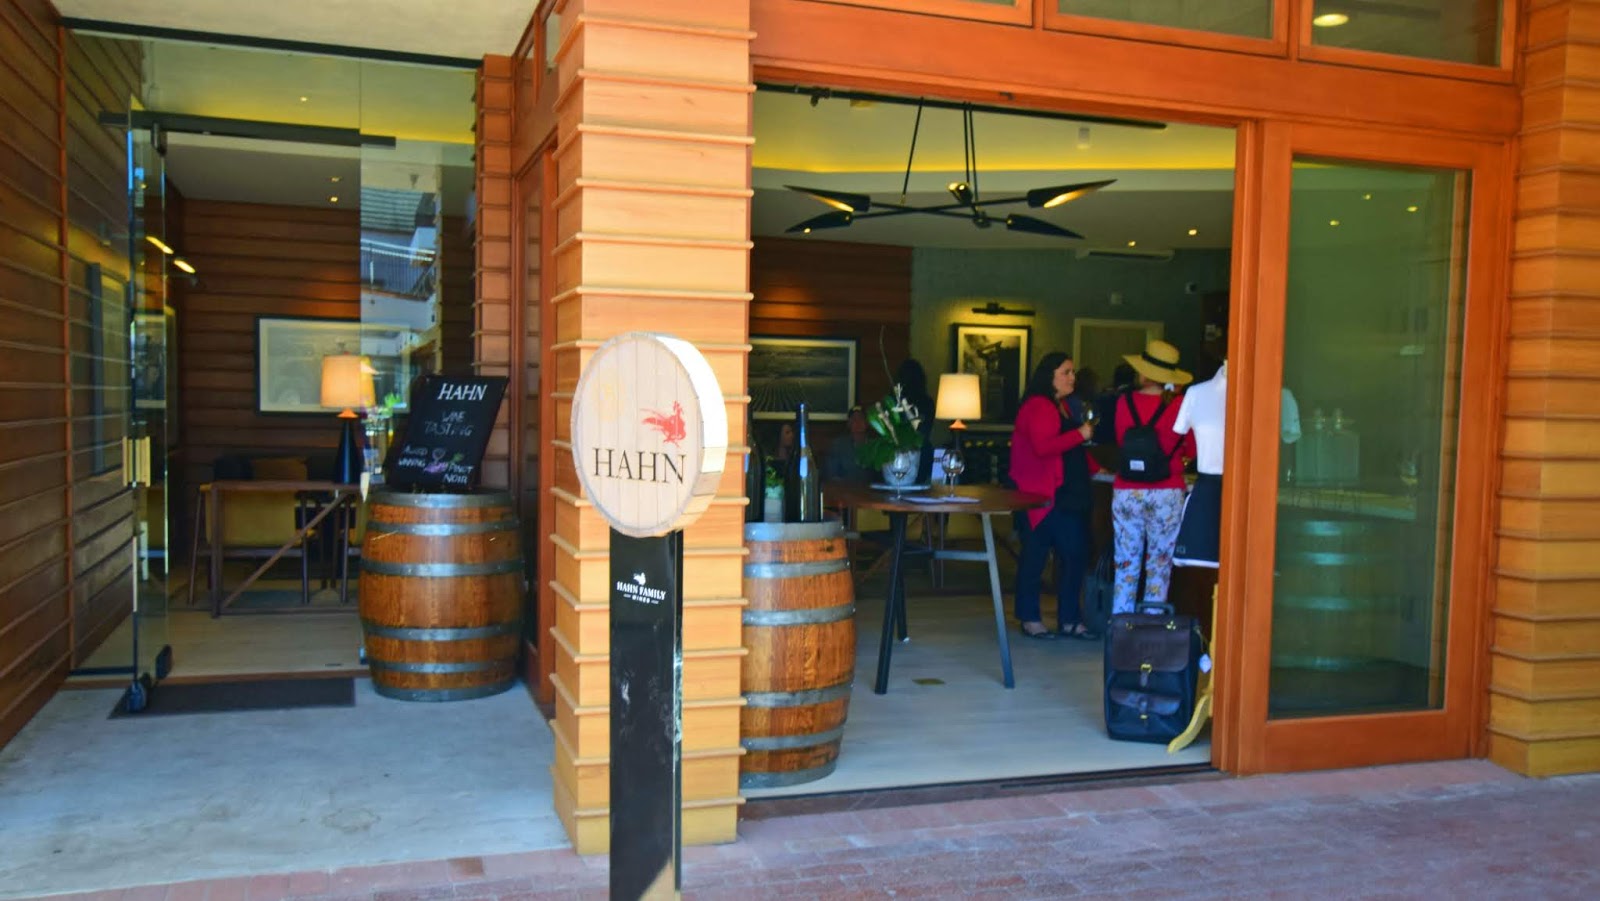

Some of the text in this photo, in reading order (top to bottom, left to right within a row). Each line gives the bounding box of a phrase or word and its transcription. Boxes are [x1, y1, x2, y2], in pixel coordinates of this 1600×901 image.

[437, 383, 488, 401] HAHN
[592, 447, 687, 485] HAHN
[444, 474, 468, 485] NOIR
[616, 581, 667, 601] HAHN FAMILY
